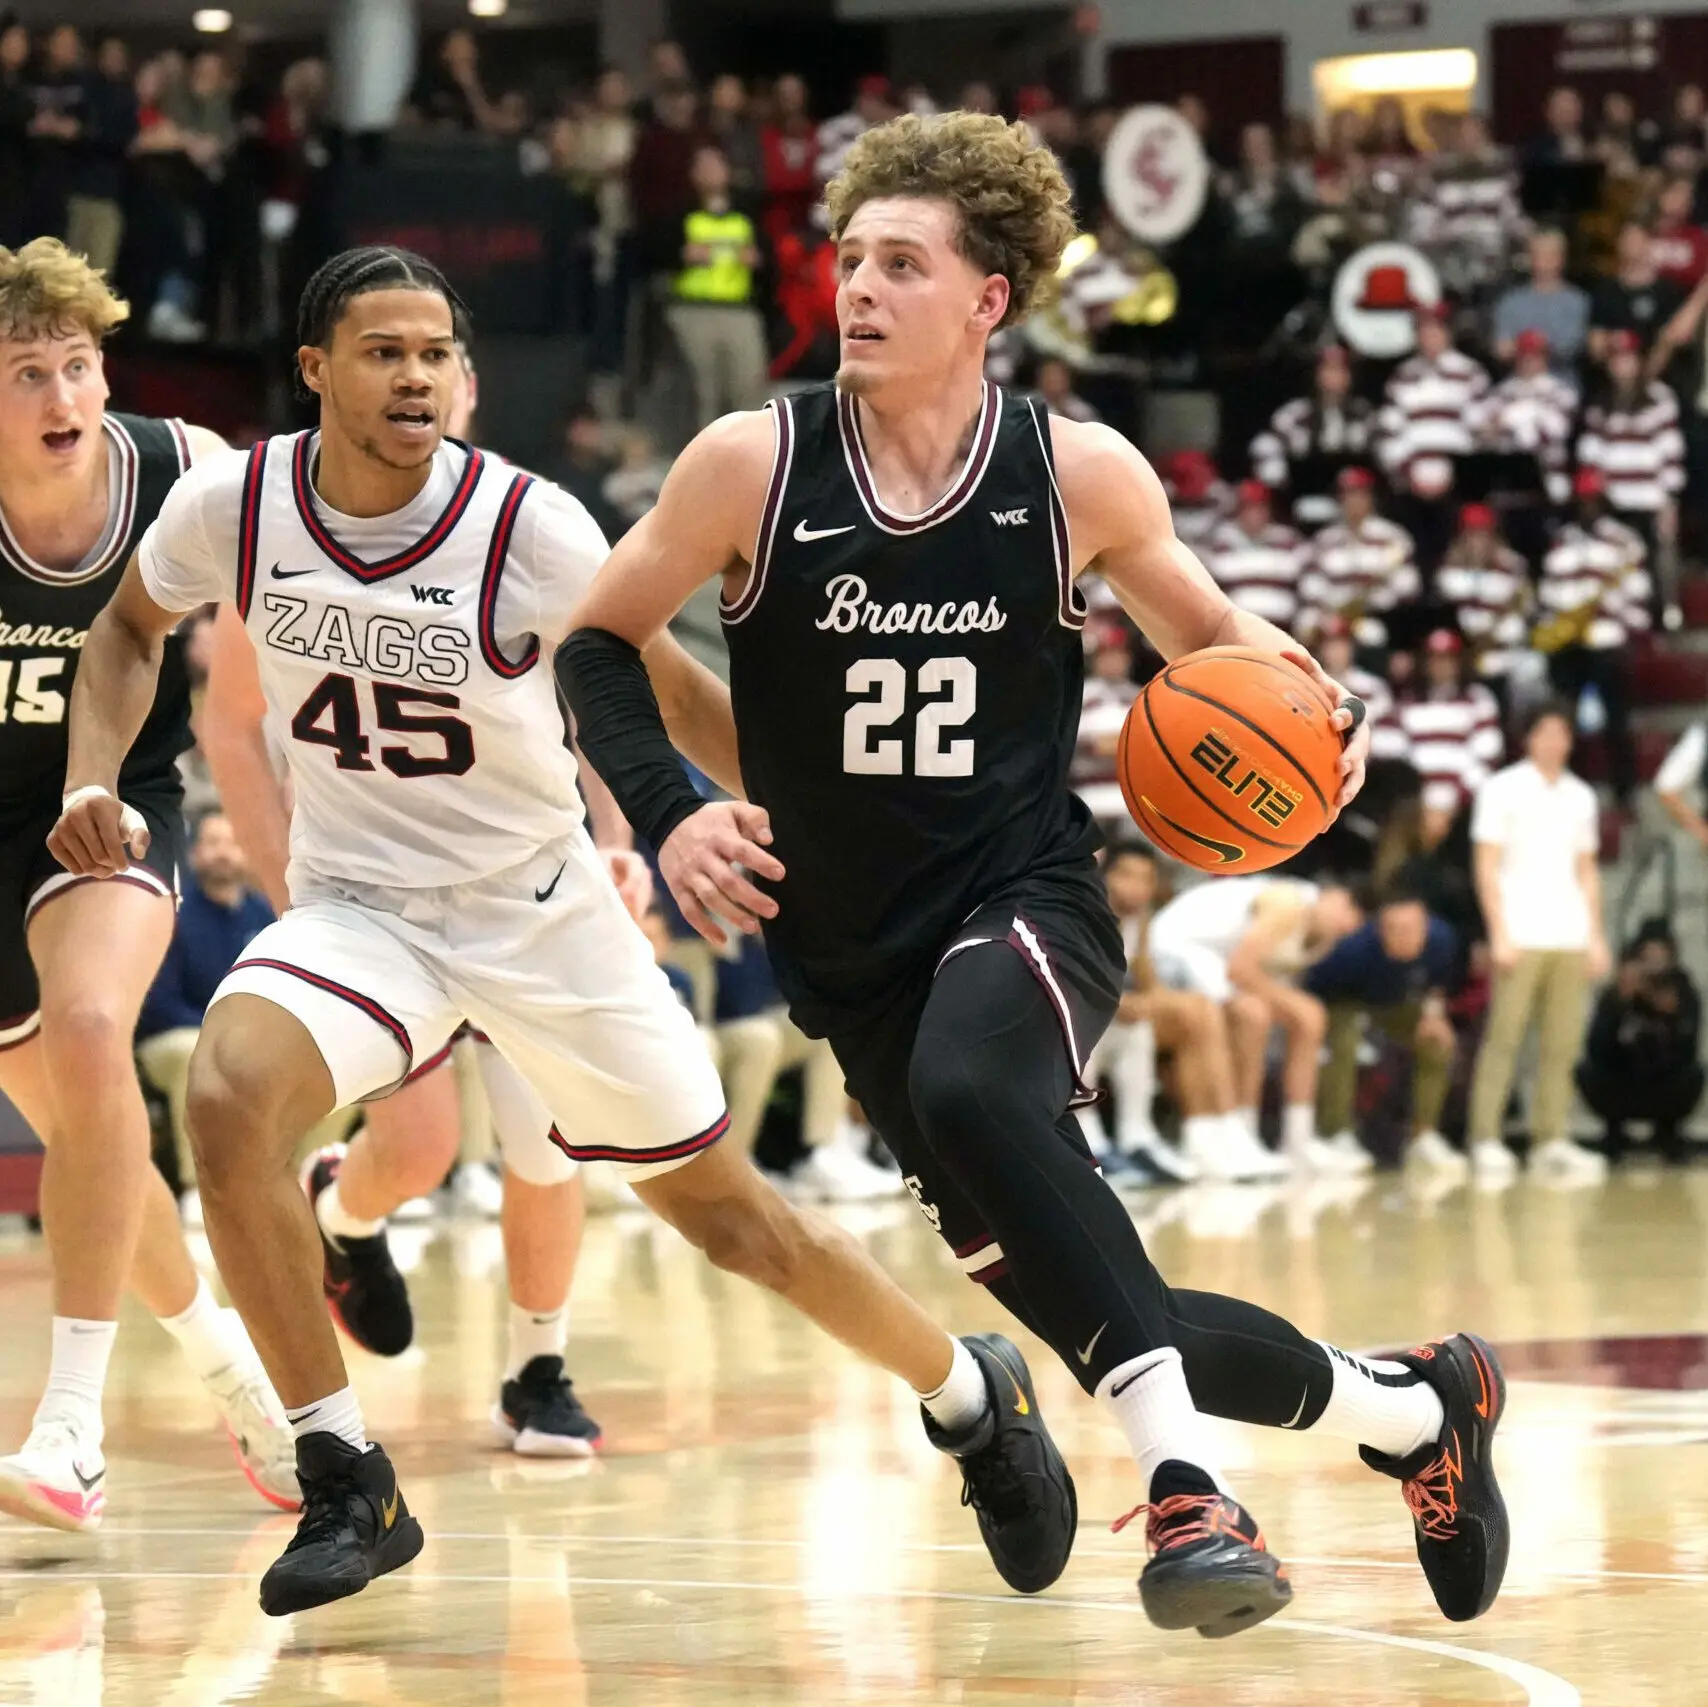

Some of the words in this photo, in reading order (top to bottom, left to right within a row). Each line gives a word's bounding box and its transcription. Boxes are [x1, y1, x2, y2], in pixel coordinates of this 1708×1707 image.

[989, 508, 1030, 527] WCC
[0, 607, 89, 648] ronco
[410, 584, 455, 606] WCC
[815, 574, 1007, 634] Broncos
[264, 592, 470, 686] ZAGS
[291, 672, 476, 778] 45
[843, 656, 977, 777] 22
[1190, 732, 1297, 829] ELITE
